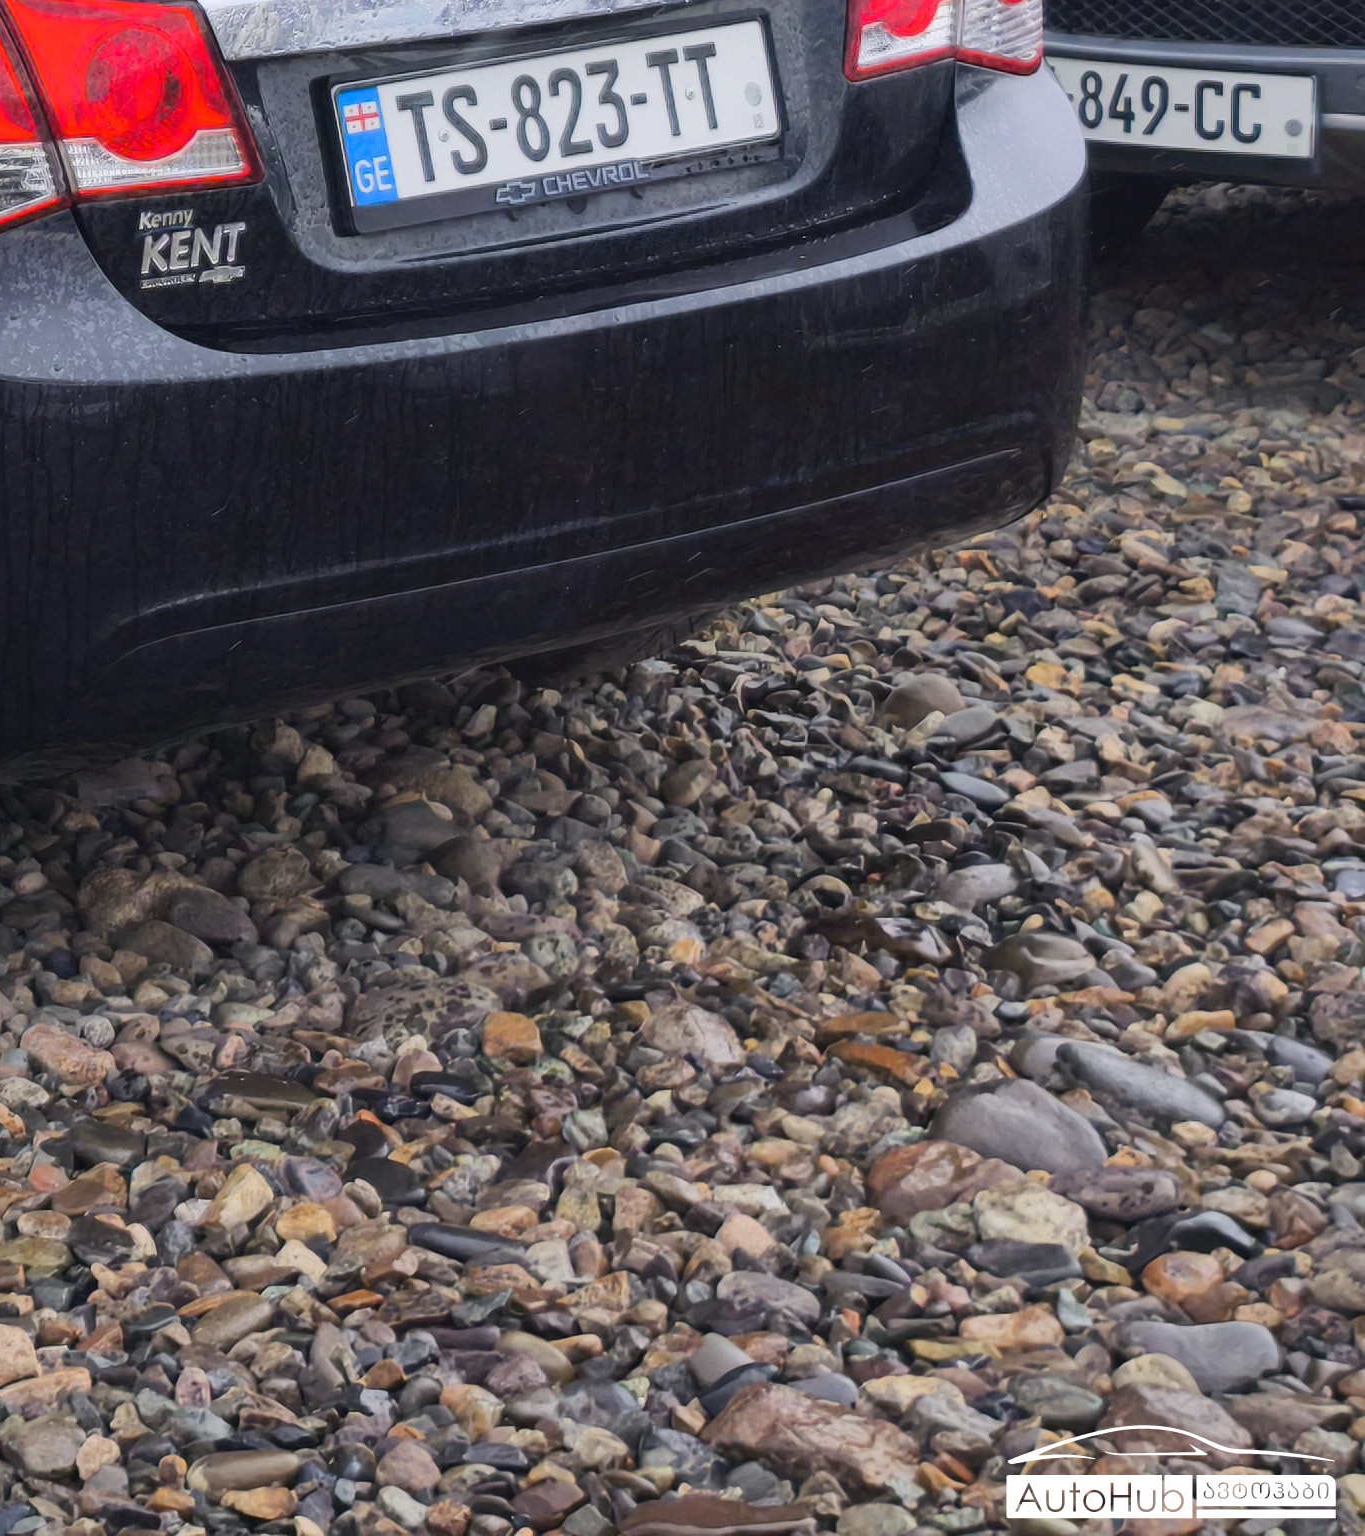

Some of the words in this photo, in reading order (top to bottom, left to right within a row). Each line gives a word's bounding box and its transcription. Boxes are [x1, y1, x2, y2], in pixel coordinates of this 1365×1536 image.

[354, 154, 395, 195] GE
[395, 41, 717, 183] TS-823-TT
[542, 161, 652, 196] CHEVROL
[138, 208, 194, 230] Kenny
[140, 221, 247, 275] KENT
